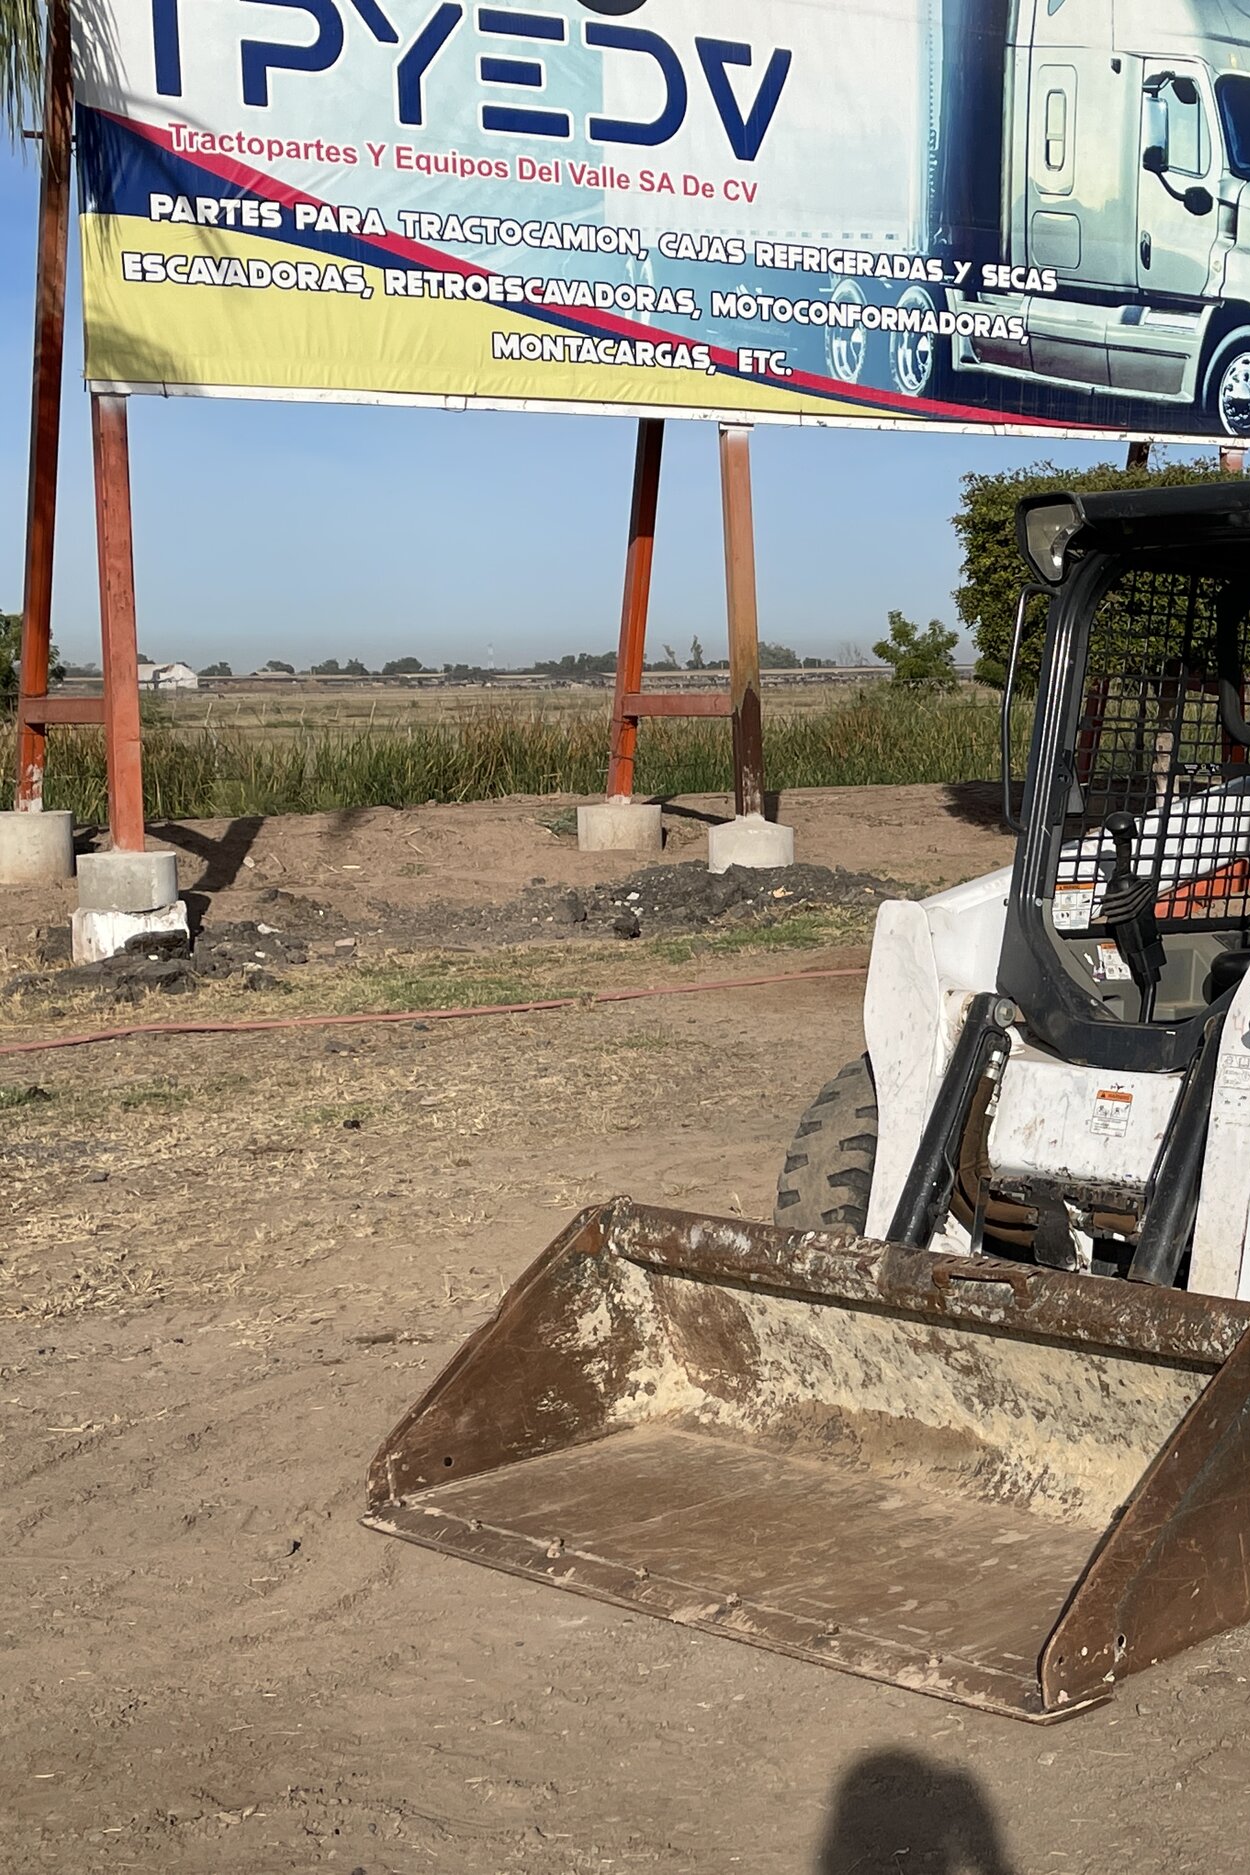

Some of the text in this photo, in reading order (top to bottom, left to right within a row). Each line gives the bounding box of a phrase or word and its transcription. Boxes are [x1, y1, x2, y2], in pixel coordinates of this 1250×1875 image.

[168, 123, 759, 203] Tractopartes Y Equipos Del Valle SA De CV
[149, 193, 1058, 293] PARTES PARA TRACTOCAMION, CAJAS REFRIGERADAS Y SECAS
[122, 251, 1030, 345] ESCAVADORAS, RETROESCAVADORAS, MOTOCONFORMADORAS,
[491, 331, 793, 377] MONTACARGAS, ETC.
